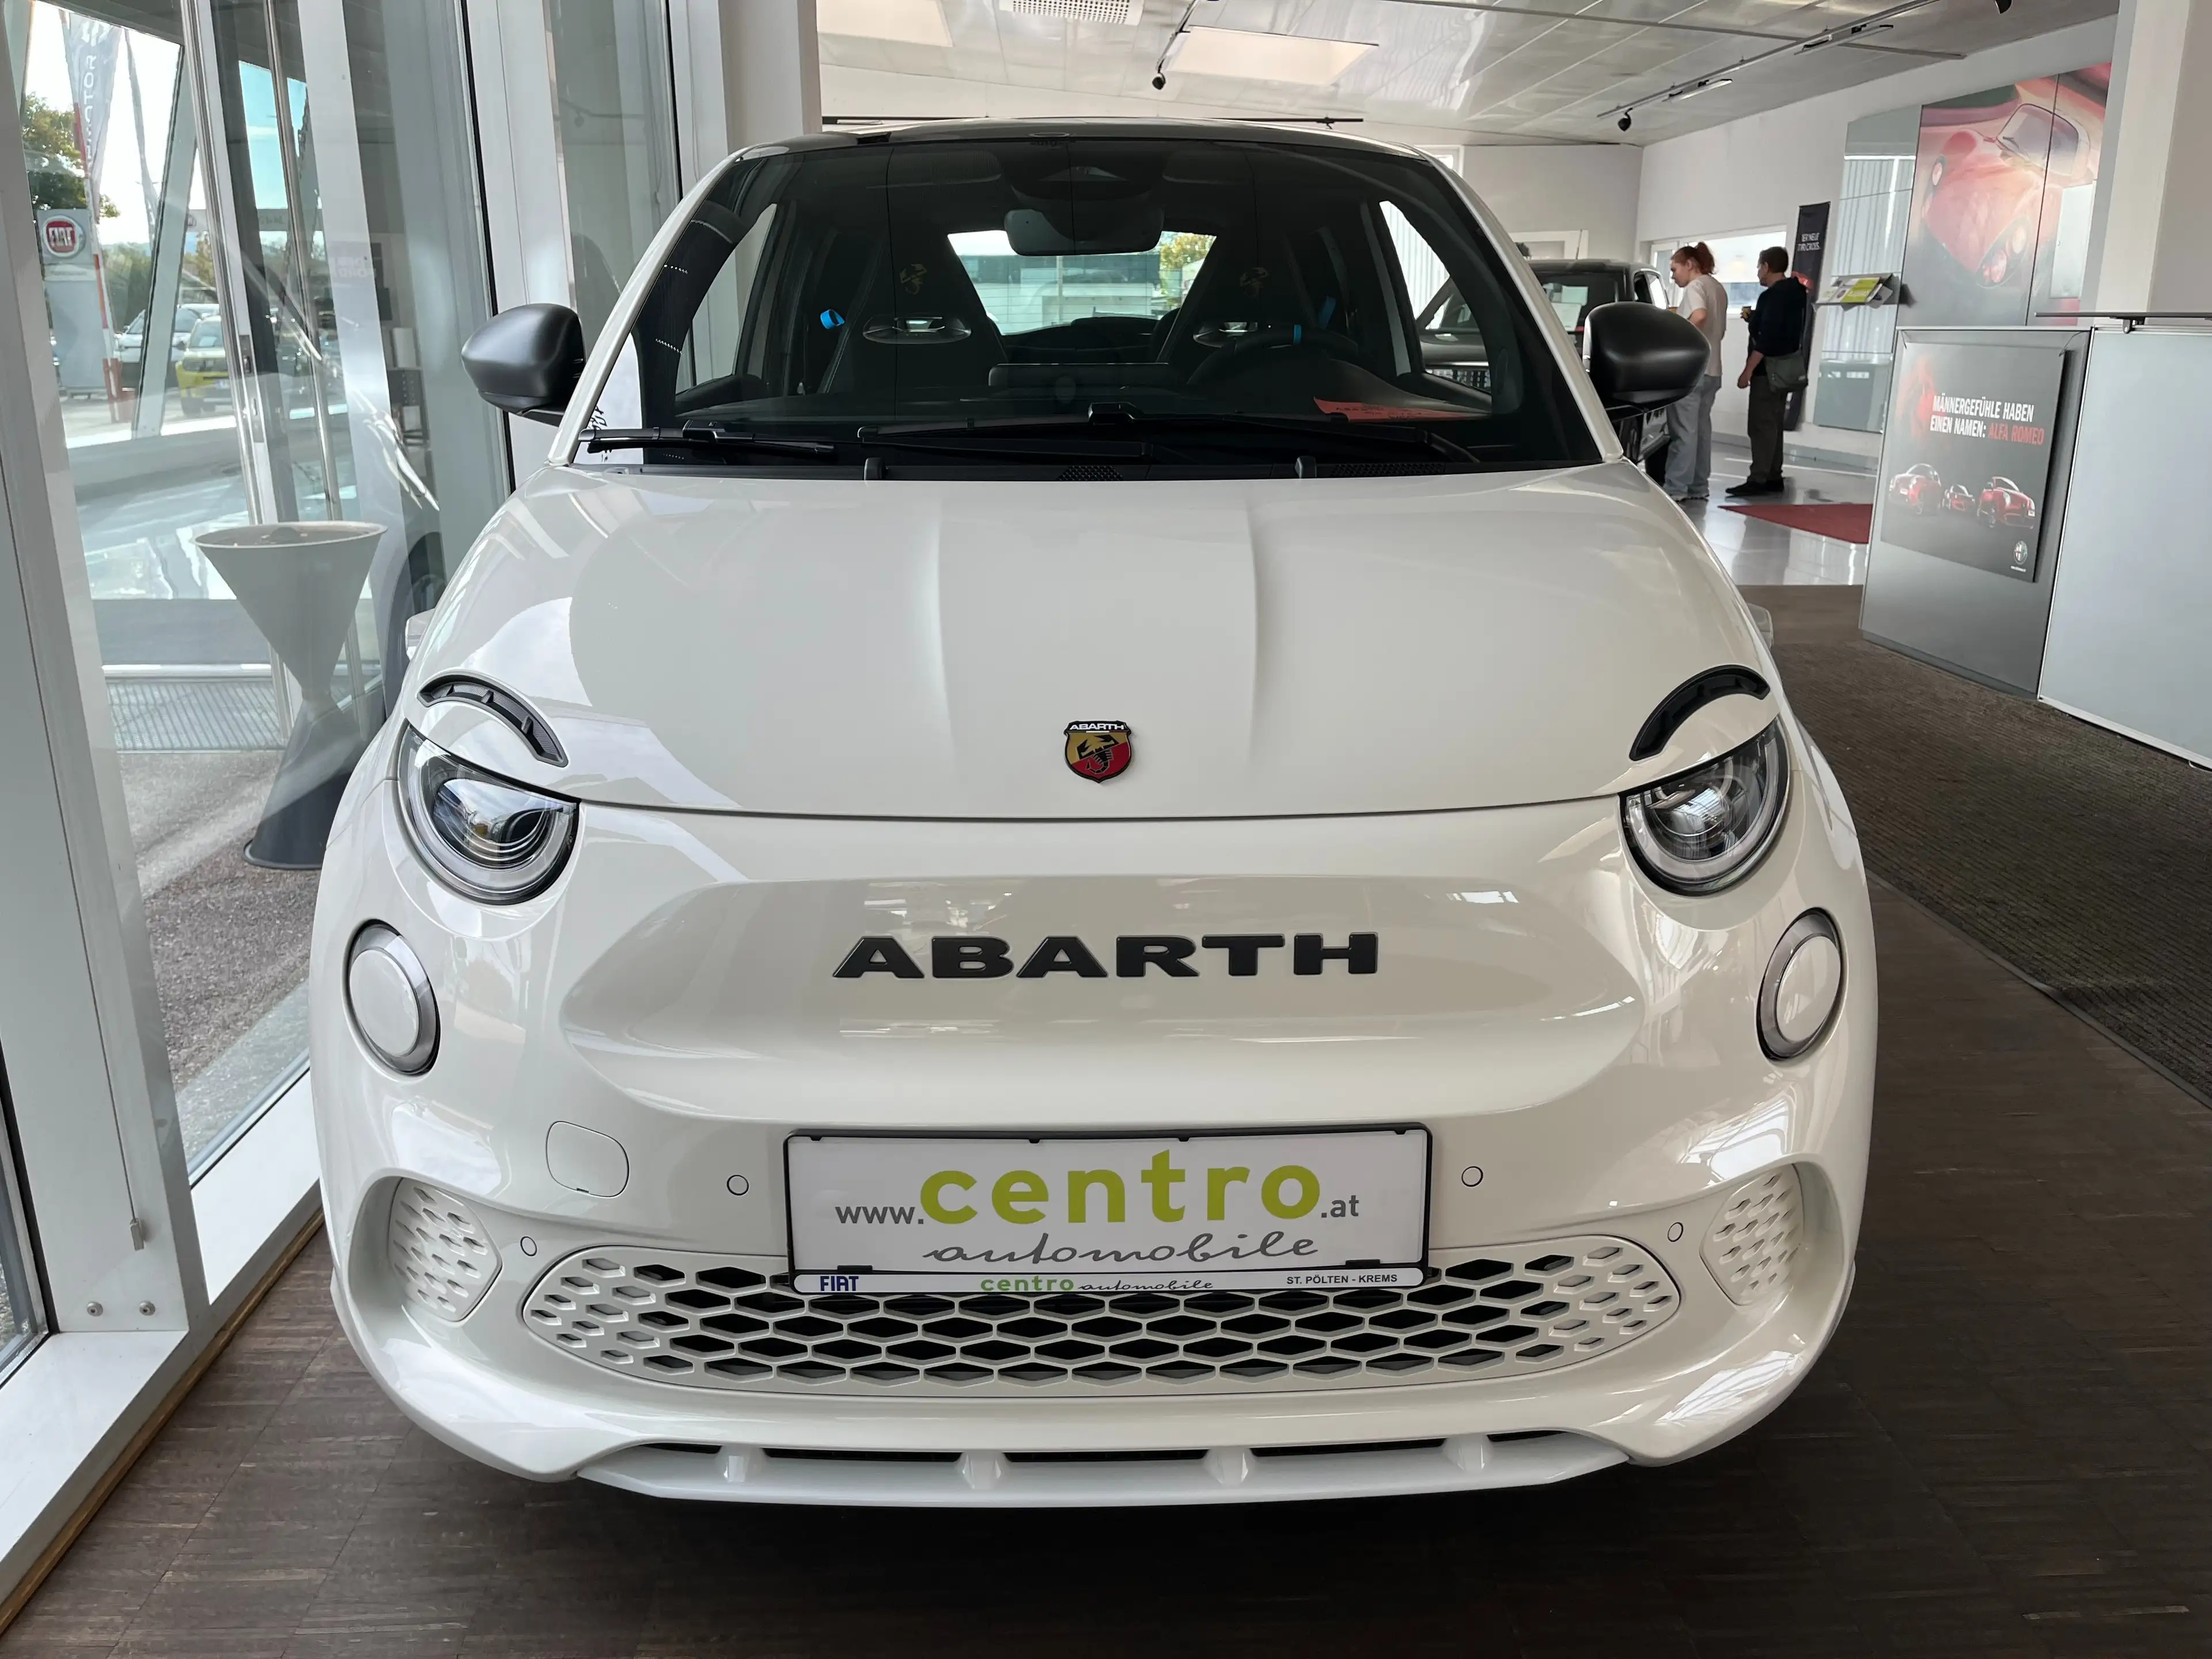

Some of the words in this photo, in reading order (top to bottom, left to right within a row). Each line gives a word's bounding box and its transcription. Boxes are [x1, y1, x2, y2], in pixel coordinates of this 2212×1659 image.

[48, 226, 73, 247] FIAT
[1932, 393, 2001, 419] MÄNNERGEFÜHLE
[2002, 403, 2035, 422] HABEN
[1930, 414, 1953, 433] EINEN
[1953, 418, 1987, 438] NAMEN:
[1988, 422, 2009, 441] ALFA
[2011, 425, 2045, 446] ROMEO
[1069, 722, 1124, 730] ABARTH
[832, 932, 1378, 979] ABARTH
[922, 1231, 1319, 1264] automobile
[820, 1275, 859, 1291] FIAT
[980, 1275, 1074, 1291] centro
[1078, 1280, 1213, 1290] automobile
[1286, 1275, 1302, 1285] ST.
[1305, 1274, 1349, 1285] PÖLTEN
[1358, 1273, 1397, 1283] KREMS
